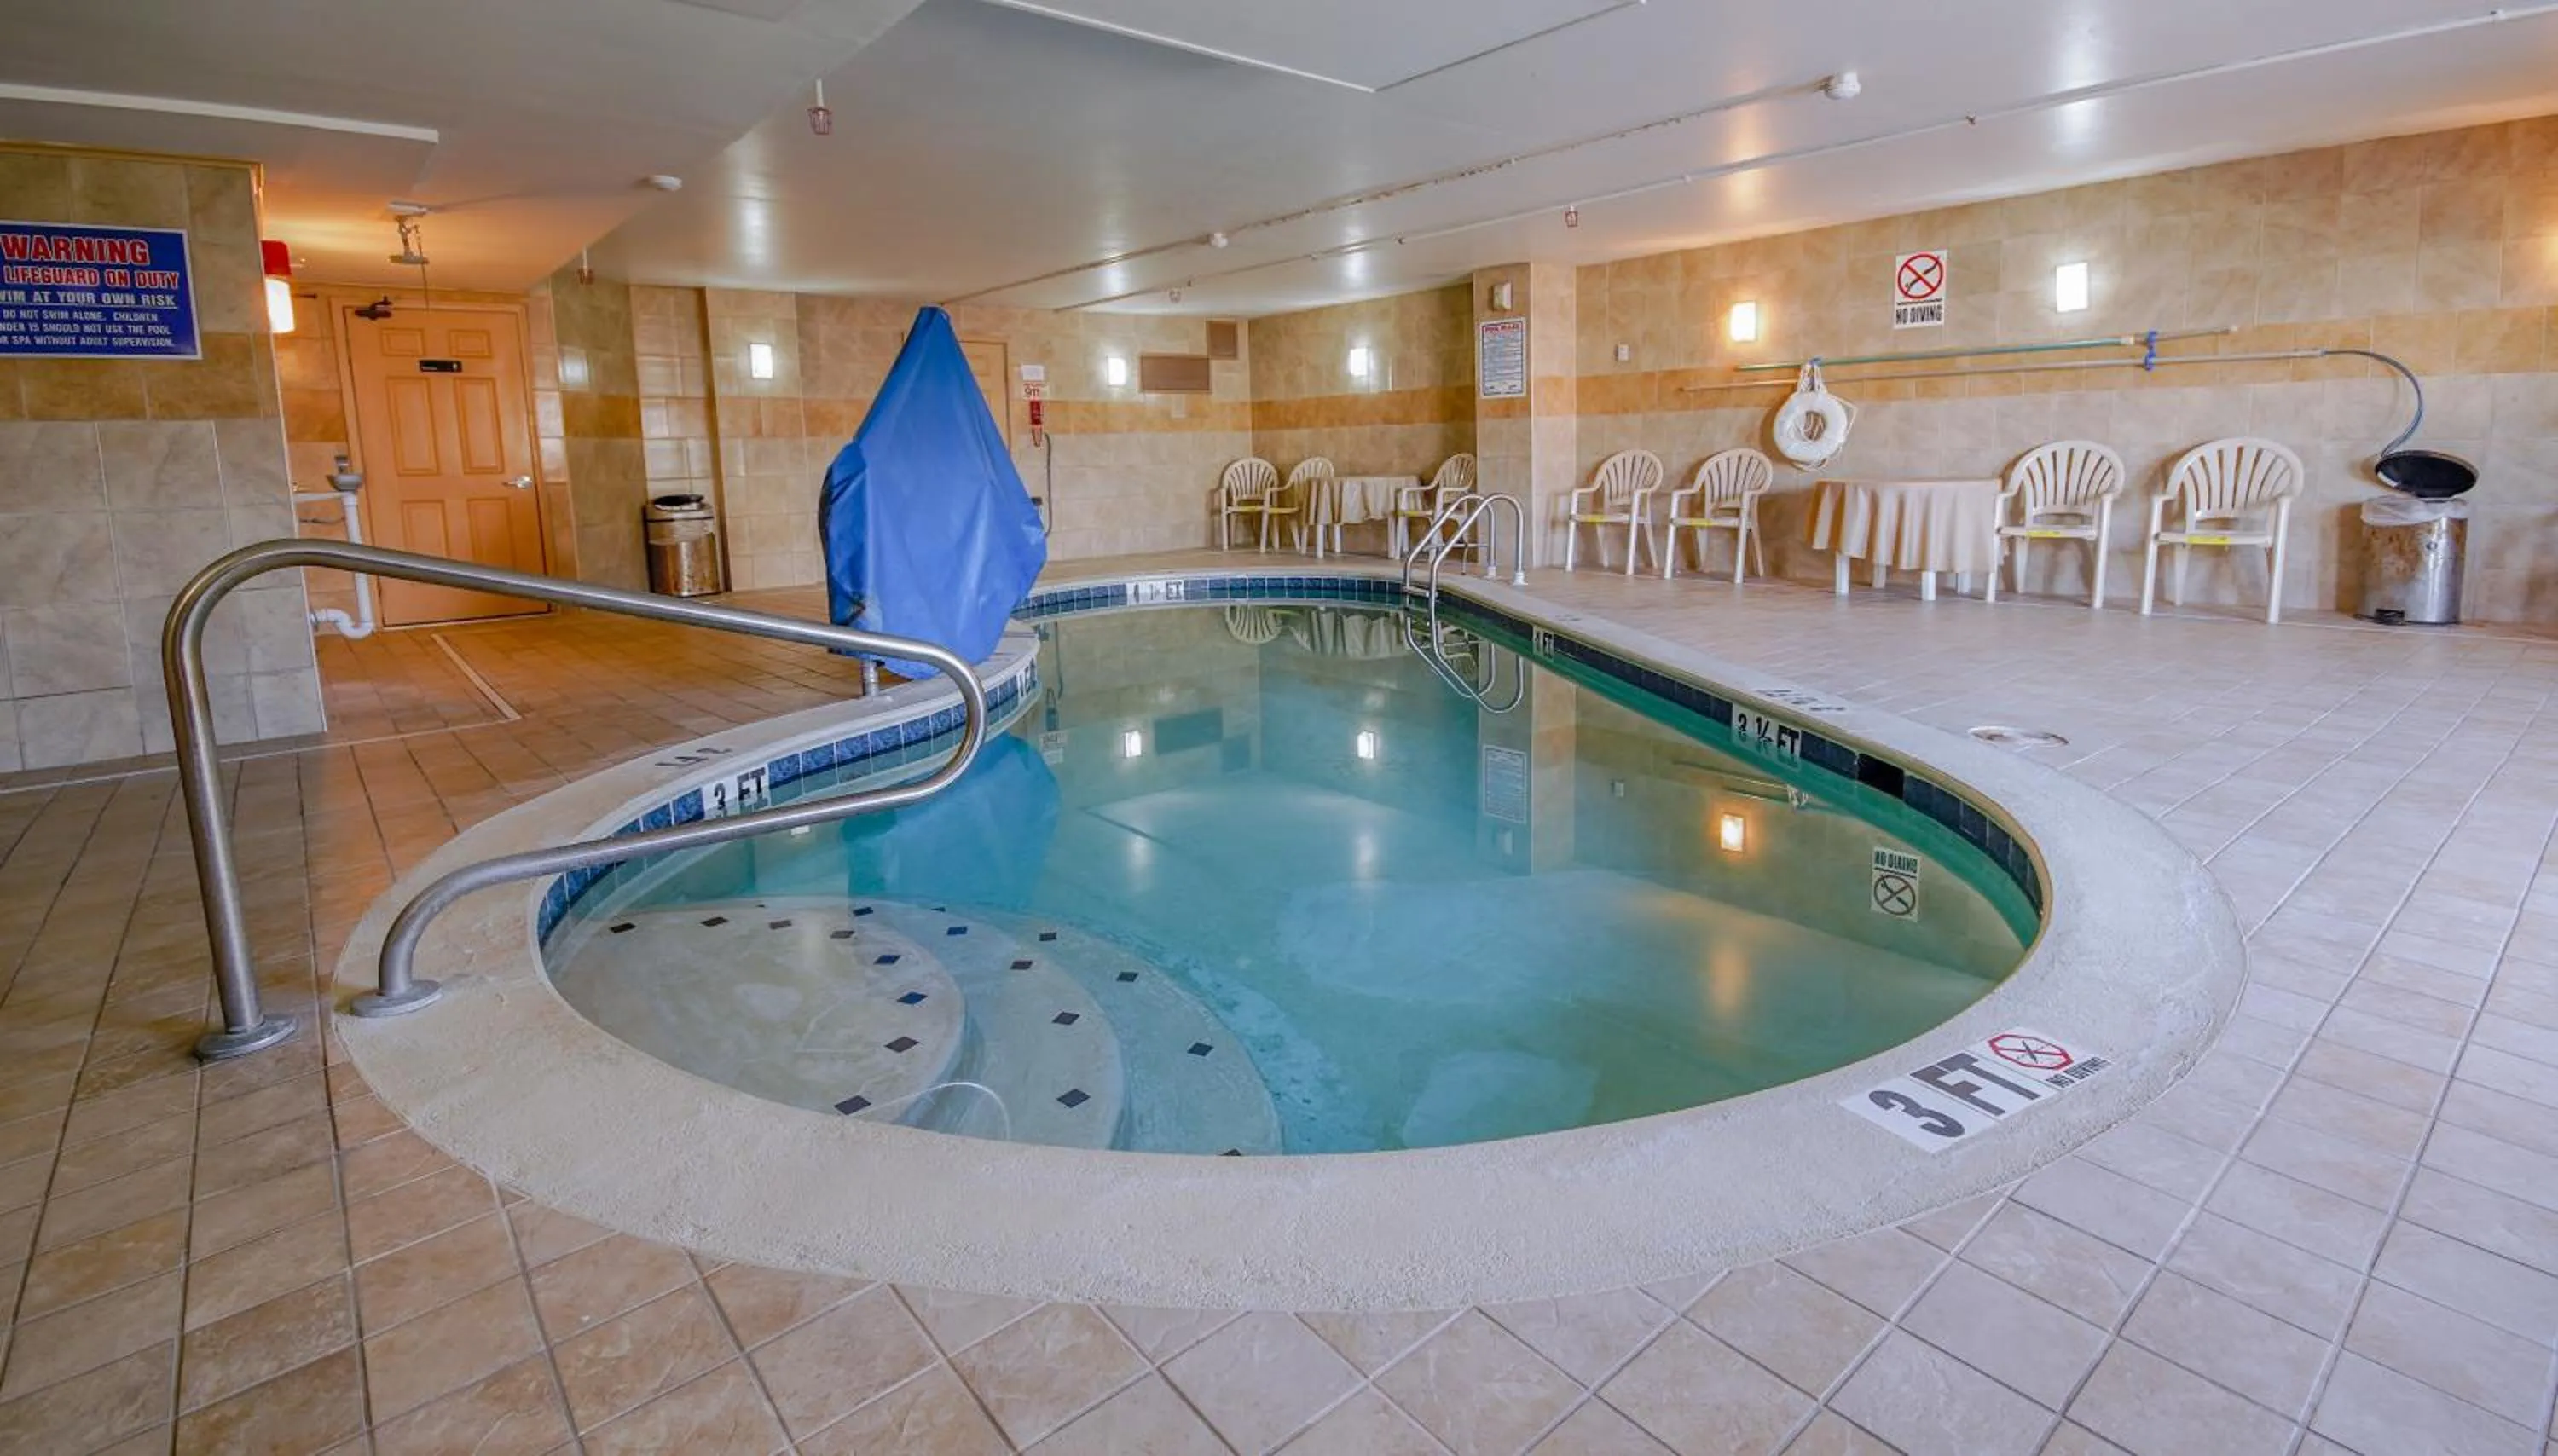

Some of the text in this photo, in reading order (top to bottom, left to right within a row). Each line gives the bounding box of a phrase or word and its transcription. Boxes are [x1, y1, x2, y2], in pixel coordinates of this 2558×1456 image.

[0, 234, 150, 265] WARNING
[3, 265, 179, 289] LIFEGUARD ON DUTY
[0, 291, 176, 306] IM AT YOUR OWN RISK
[3, 309, 16, 319] DO
[20, 309, 39, 320] NOT
[42, 310, 69, 320] SWIM
[113, 311, 159, 321] CHILDREN
[1895, 304, 1942, 324] NO DIVING
[0, 322, 25, 332] NDER
[43, 323, 80, 333] SHOULD
[83, 324, 101, 333] NOT
[11, 335, 32, 344] SPA
[34, 336, 77, 345] WITHOUT
[1868, 1052, 2042, 1138] 3 FT
